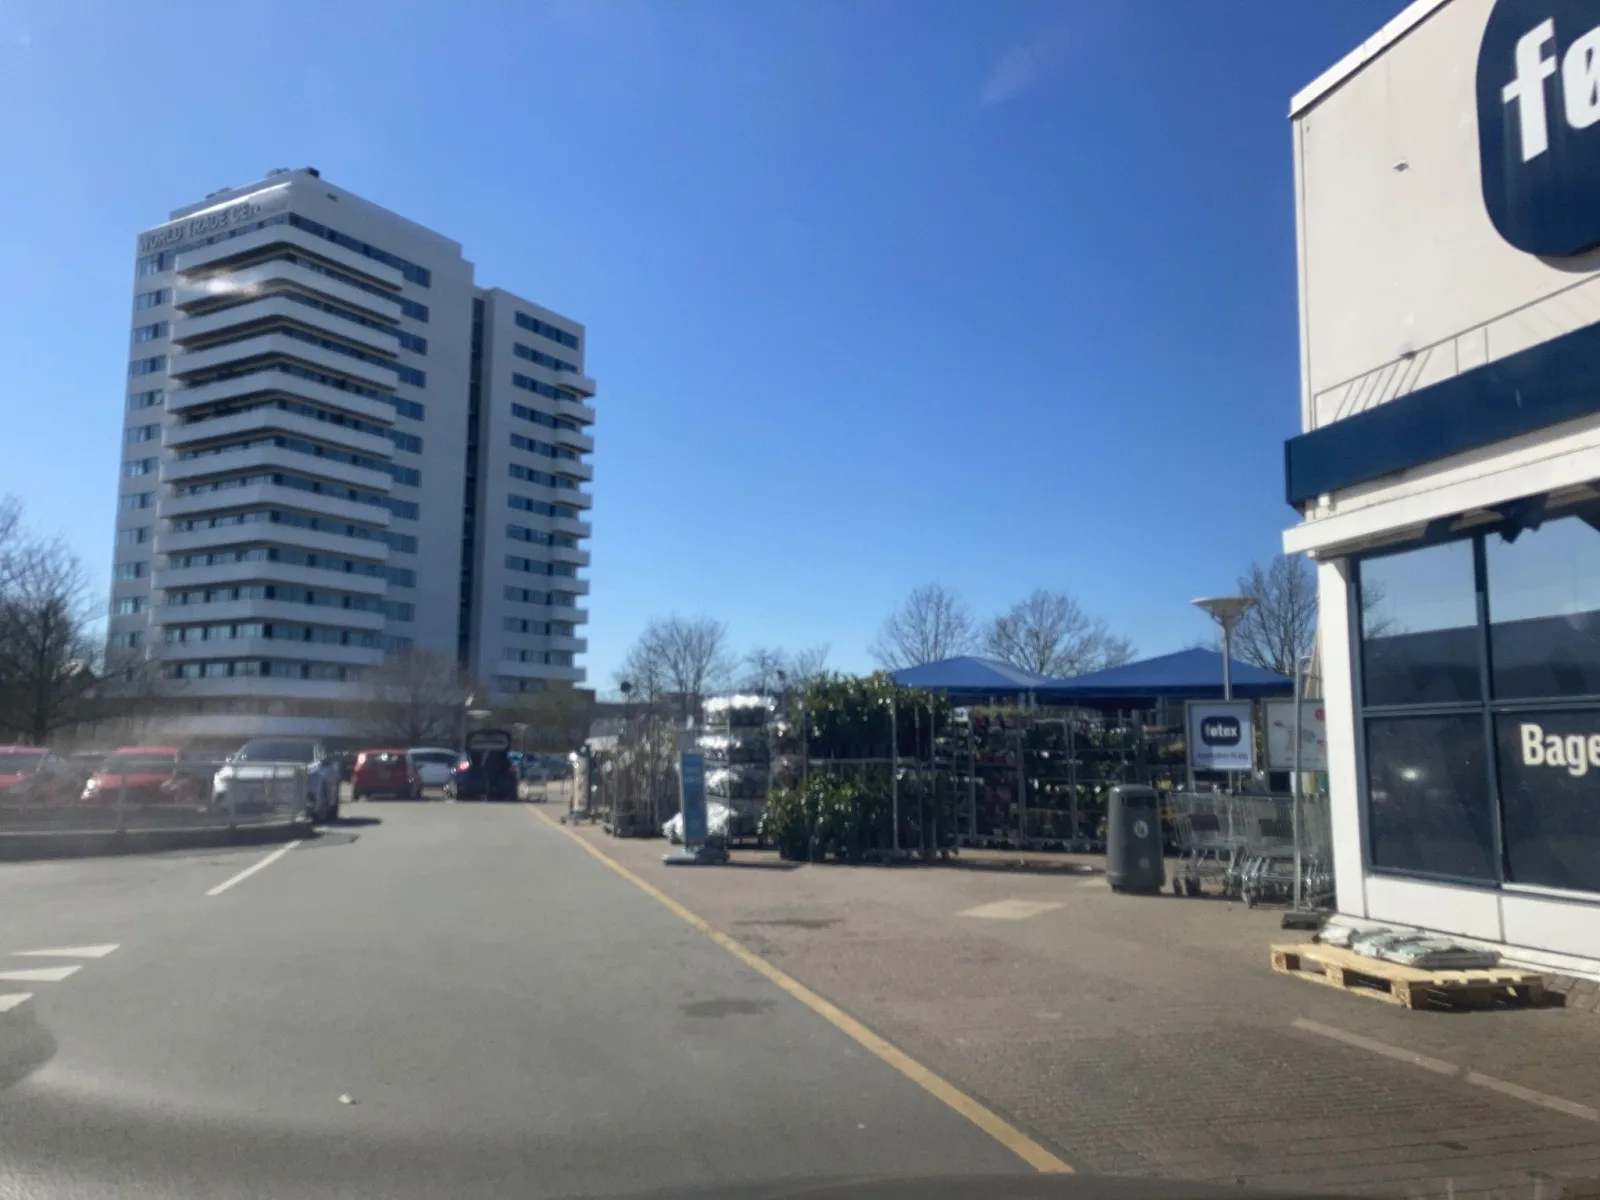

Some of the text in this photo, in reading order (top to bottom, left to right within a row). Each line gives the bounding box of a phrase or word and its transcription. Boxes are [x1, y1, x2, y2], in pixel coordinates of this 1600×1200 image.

[140, 226, 184, 252] WORLD
[188, 211, 229, 238] TRADE
[1520, 723, 1600, 776] Bage
